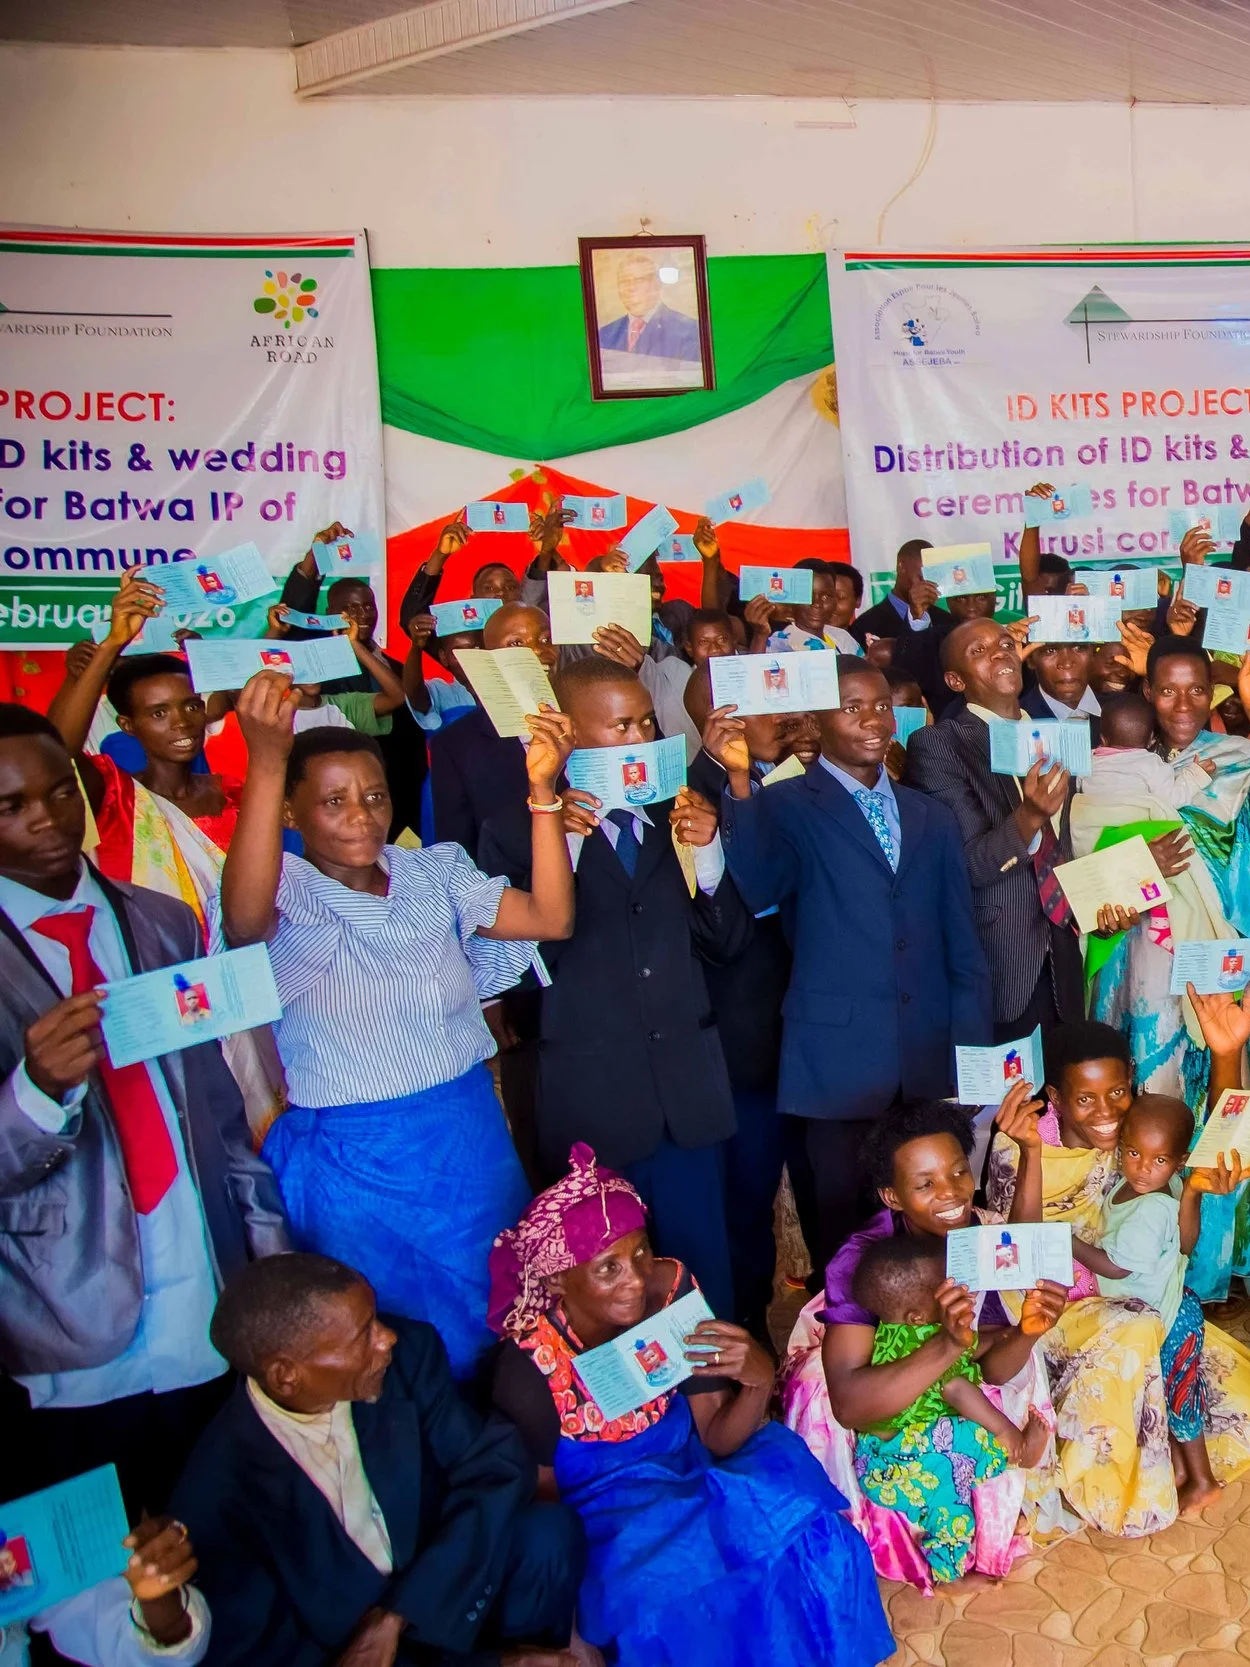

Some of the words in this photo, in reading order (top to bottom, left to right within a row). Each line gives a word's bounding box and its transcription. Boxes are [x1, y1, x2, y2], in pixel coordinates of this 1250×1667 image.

[250, 335, 335, 348] AFRICAN
[267, 350, 319, 363] ROAD
[1007, 394, 1038, 421] ID
[1050, 392, 1111, 420] KITS
[43, 439, 112, 471] kits
[128, 442, 154, 472] &
[168, 441, 347, 481] wedding
[874, 440, 1065, 473] Distribution
[1077, 437, 1109, 465] of
[1121, 436, 1152, 463] ID
[1165, 434, 1218, 462] kits
[1229, 434, 1250, 459] &
[0, 488, 48, 520] or
[64, 490, 195, 521] Batwa
[210, 491, 244, 521] IP
[259, 491, 297, 522] of
[1127, 480, 1171, 508] for
[1003, 526, 1104, 559] Krusi
